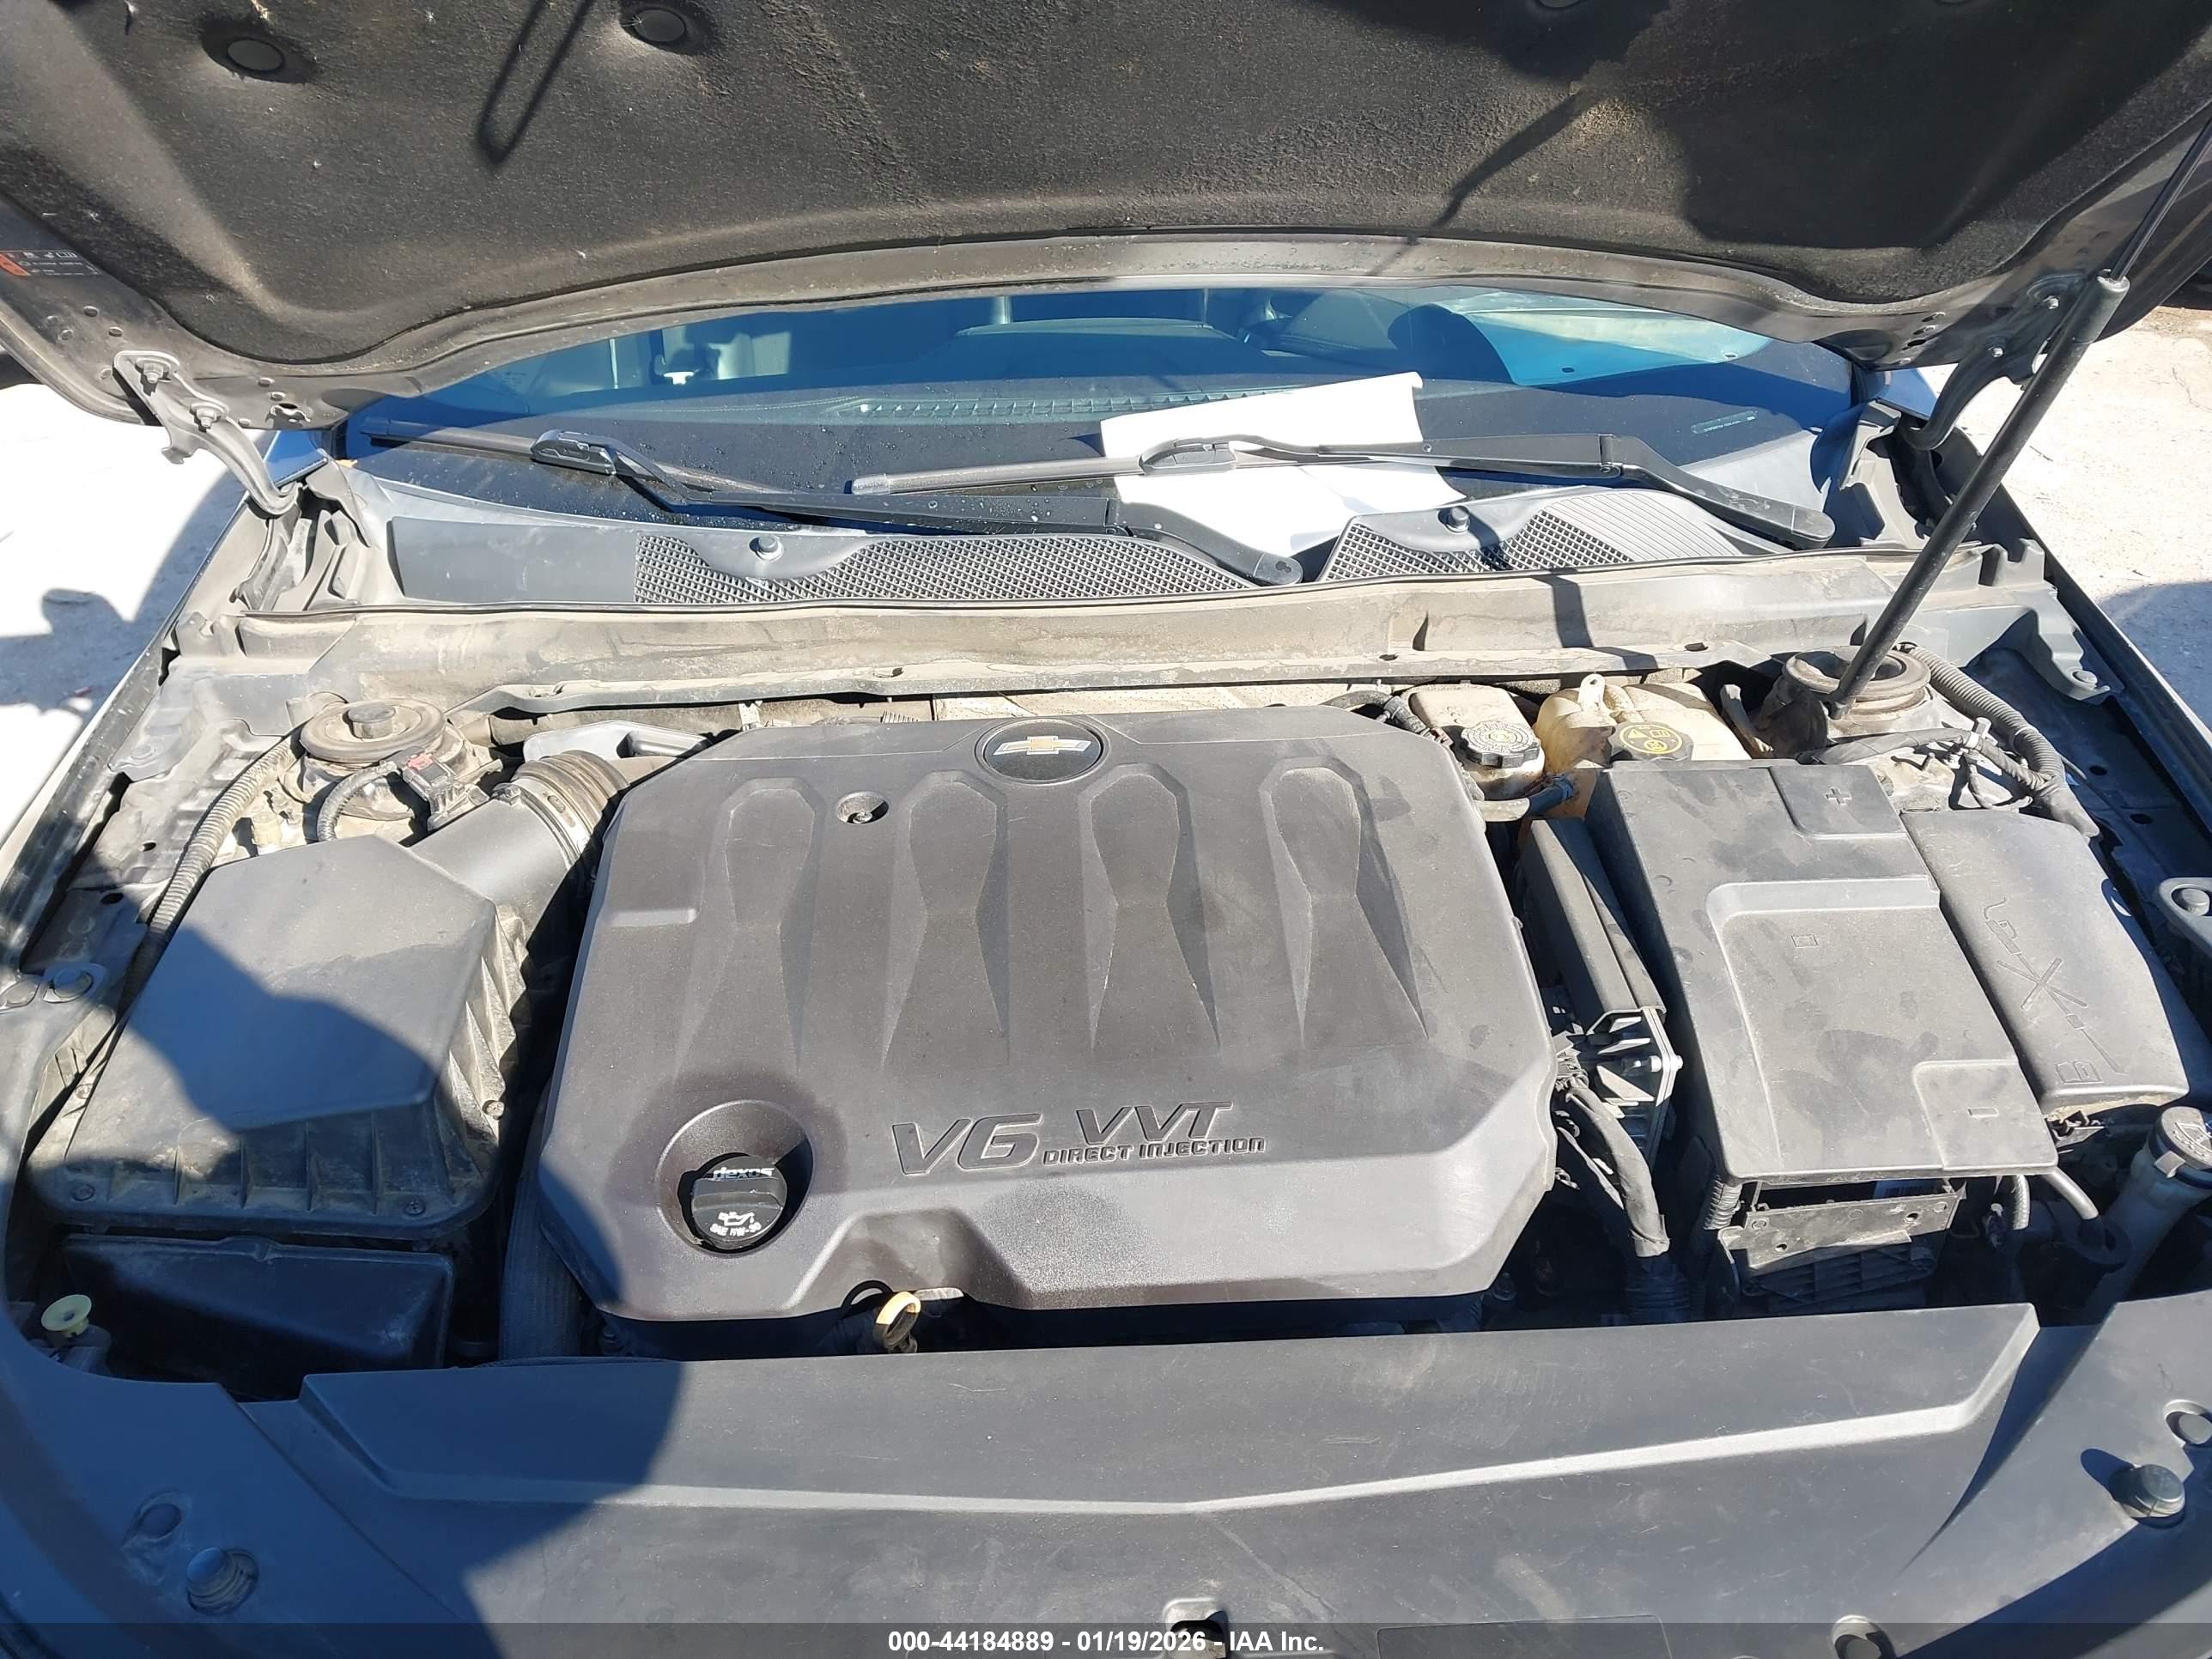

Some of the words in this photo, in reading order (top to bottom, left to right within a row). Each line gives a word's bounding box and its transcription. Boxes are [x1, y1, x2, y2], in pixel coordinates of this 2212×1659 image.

[892, 1113, 1042, 1176] V6
[1076, 1102, 1233, 1146] VVT
[1042, 1145, 1134, 1165] DIRECT
[1139, 1137, 1266, 1158] INJECTION
